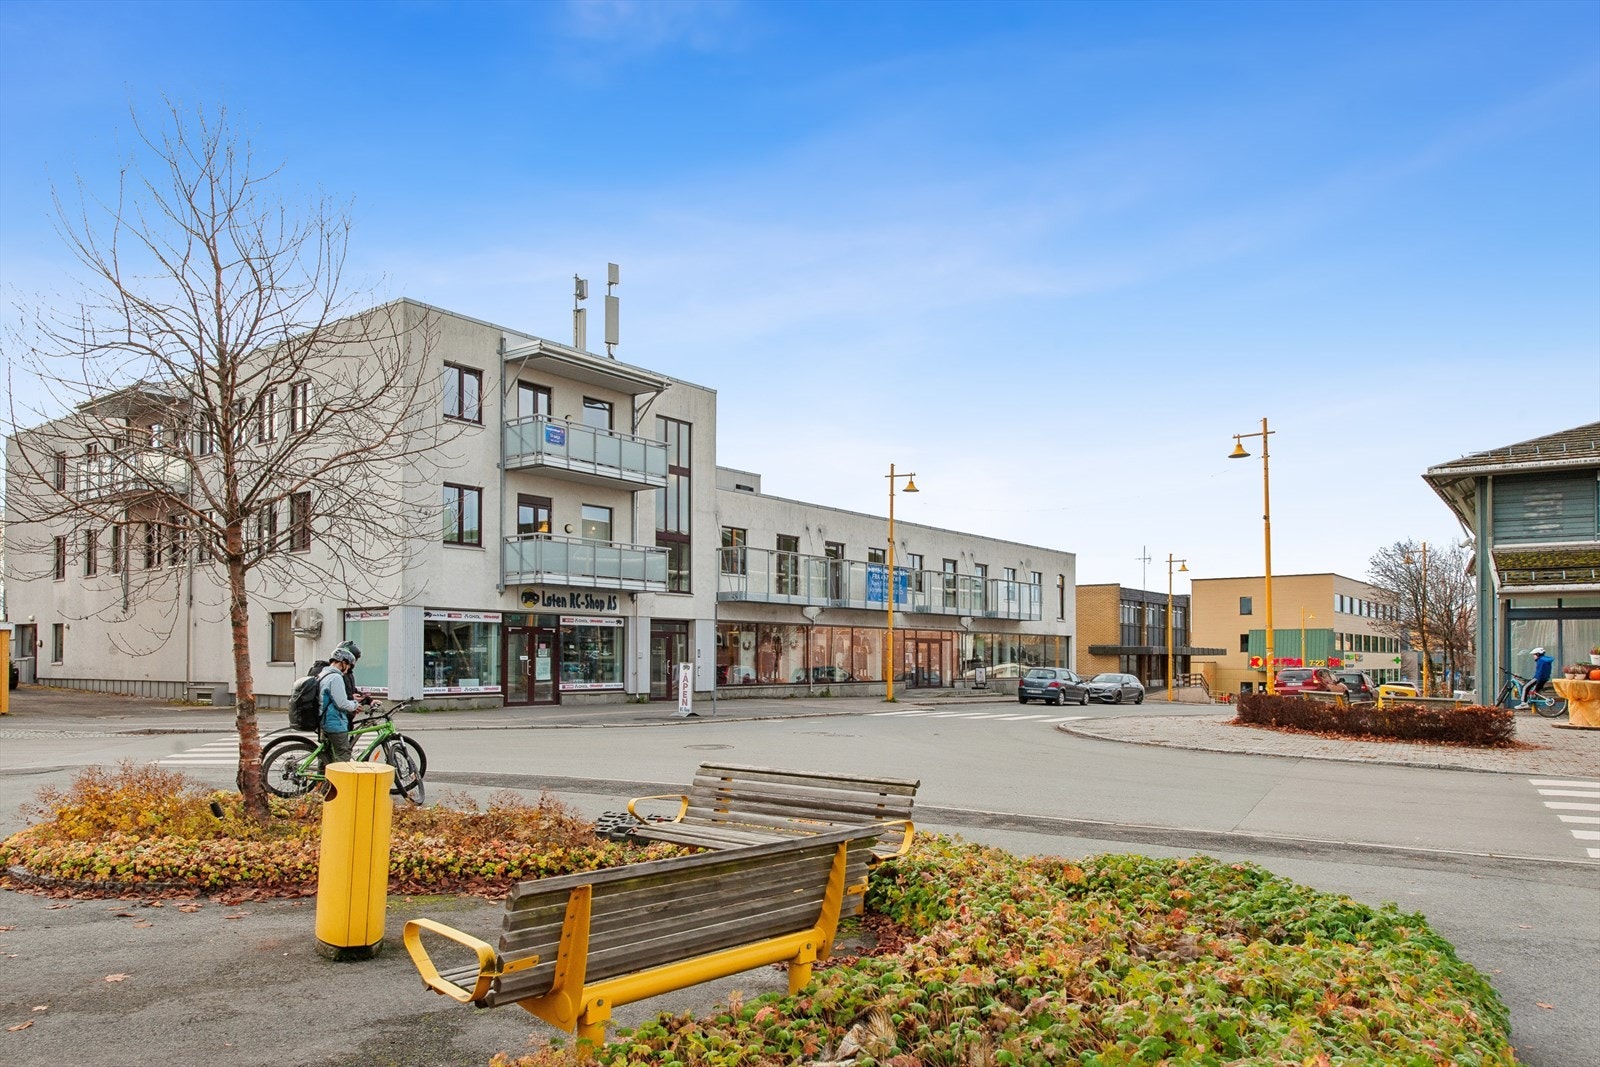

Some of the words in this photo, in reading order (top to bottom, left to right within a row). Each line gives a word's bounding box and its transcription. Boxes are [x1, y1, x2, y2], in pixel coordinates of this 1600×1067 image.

[569, 592, 605, 612] RC-Shop
[607, 594, 617, 611] AS
[1309, 659, 1325, 667] 7-23
